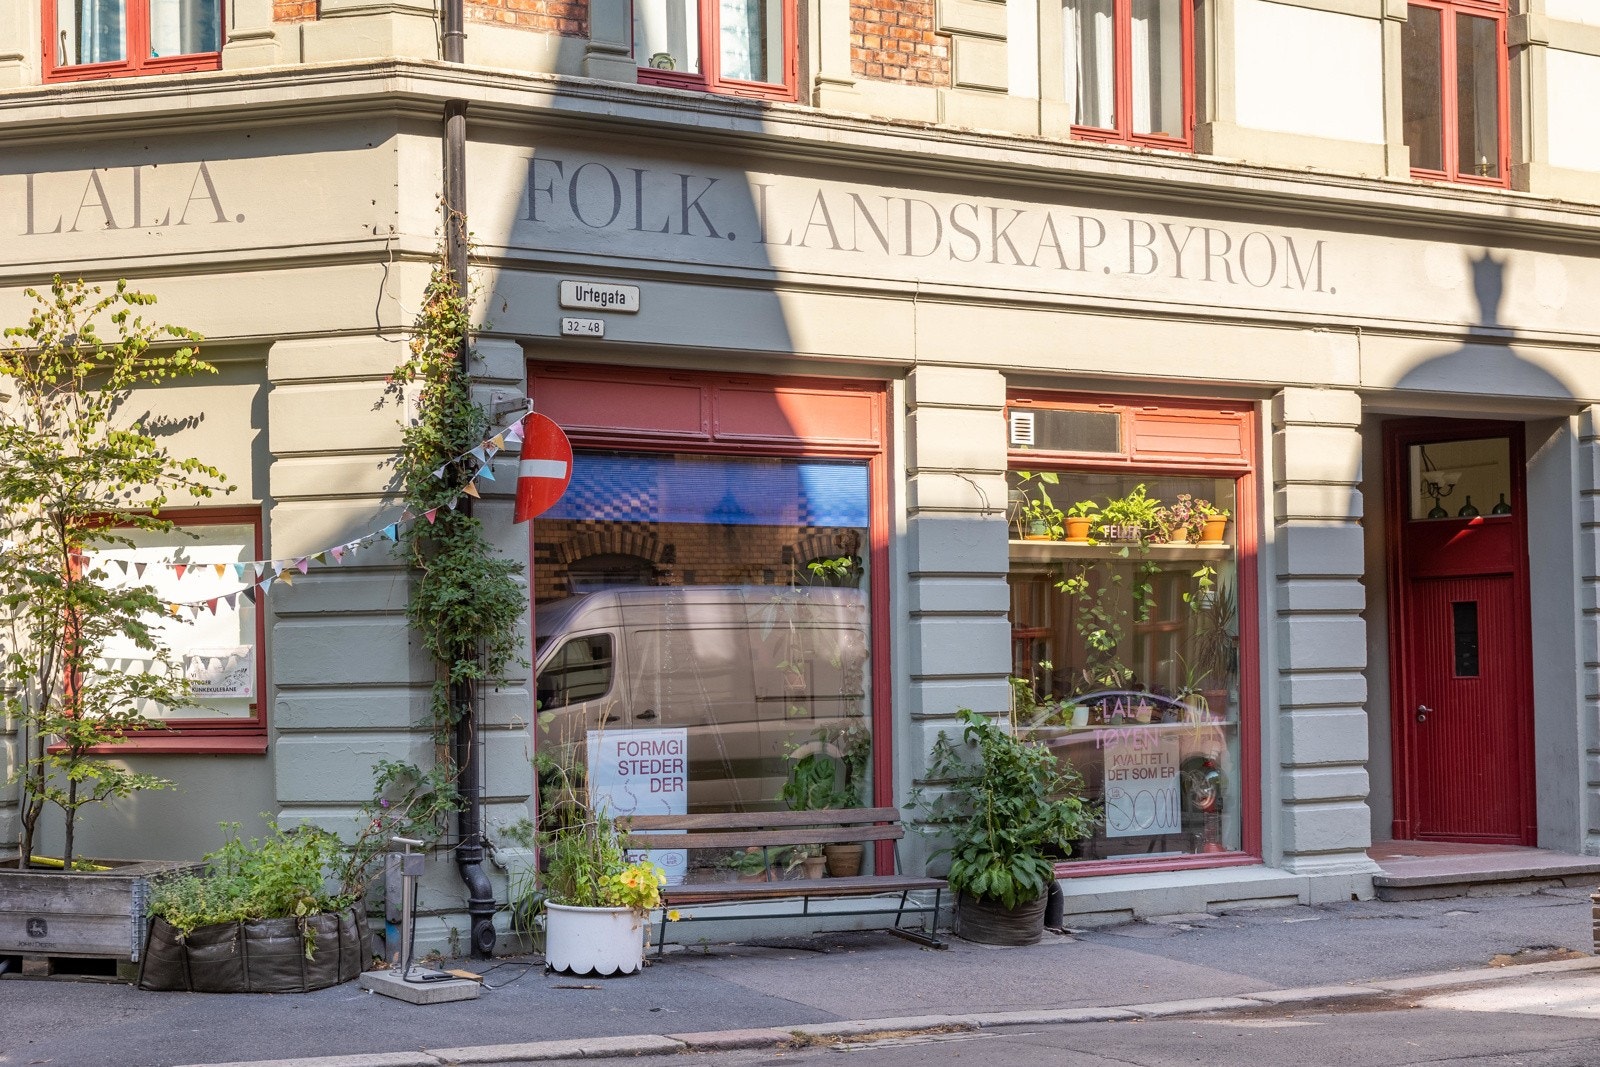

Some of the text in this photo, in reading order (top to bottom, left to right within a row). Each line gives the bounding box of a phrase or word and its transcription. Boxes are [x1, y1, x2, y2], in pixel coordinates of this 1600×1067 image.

[18, 159, 245, 236] LALA.
[519, 156, 737, 241] FOLK.
[575, 286, 626, 307] Urtegata
[617, 739, 683, 757] FORMGI
[618, 758, 684, 776] STEDER
[1113, 753, 1163, 766] KVALITET
[1108, 766, 1175, 781] DET SOM ER
[650, 776, 684, 793] DER
